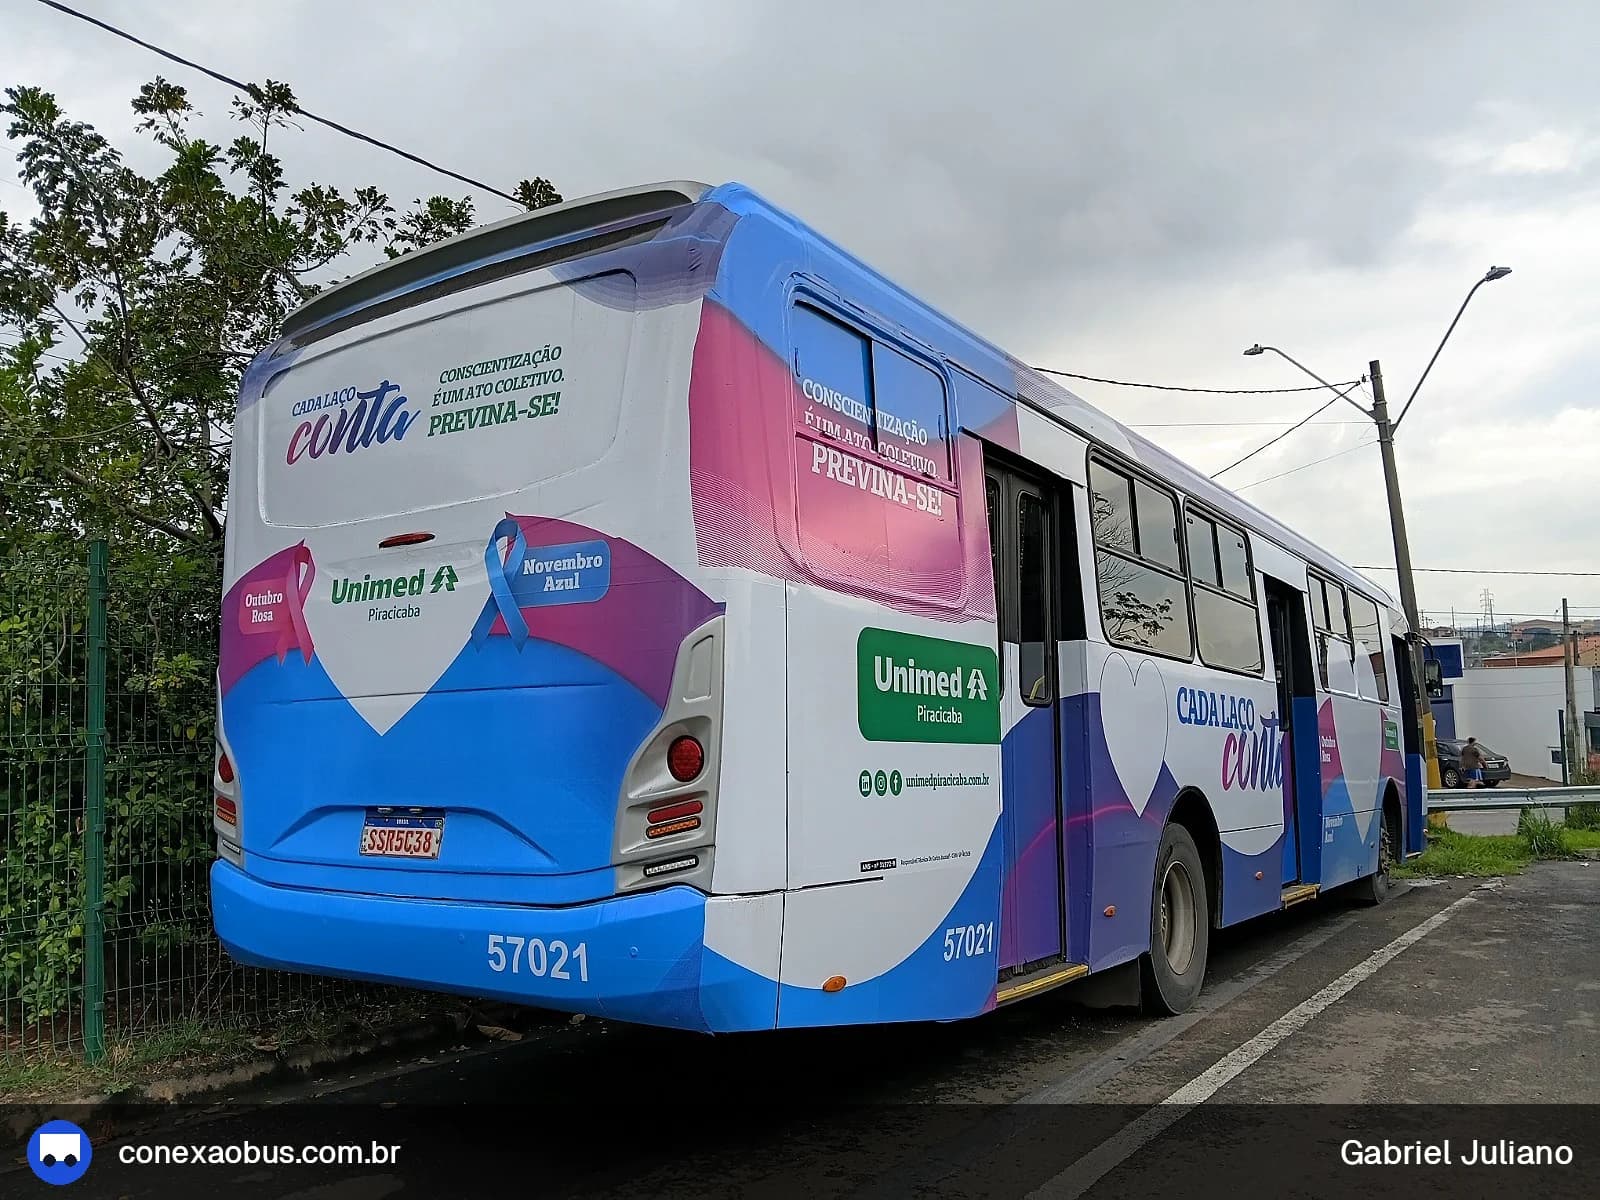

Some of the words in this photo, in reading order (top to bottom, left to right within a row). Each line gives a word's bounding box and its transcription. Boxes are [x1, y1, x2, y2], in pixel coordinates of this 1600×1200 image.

[440, 344, 562, 384] CONSCIENTIZAÇÃO
[292, 394, 322, 417] CADA
[323, 386, 356, 409] LAÇO
[432, 388, 442, 407] É
[443, 388, 464, 406] UM
[465, 382, 494, 401] ATO
[495, 368, 565, 394] COLETIVO.
[287, 380, 421, 466] conta
[427, 391, 561, 437] PREVINA-SE!
[802, 378, 928, 446] CONSCIENTIZAÇÃO
[811, 442, 943, 517] PREVINA-SE!
[523, 552, 603, 575] Novembro
[543, 572, 580, 592] Azul
[245, 590, 283, 608] Outubro
[331, 568, 426, 605] Unimed
[251, 609, 274, 623] Rosa
[368, 603, 421, 621] Piracicaba
[874, 655, 963, 698] Unimed
[917, 705, 963, 724] Piracicaba
[1177, 686, 1220, 727] CADA
[1220, 694, 1255, 732] LAÇO
[906, 772, 990, 790] unimedpiracicaba.com.br
[367, 828, 432, 853] SSR5C38
[487, 934, 588, 982] 57021
[943, 921, 993, 962] 57021
